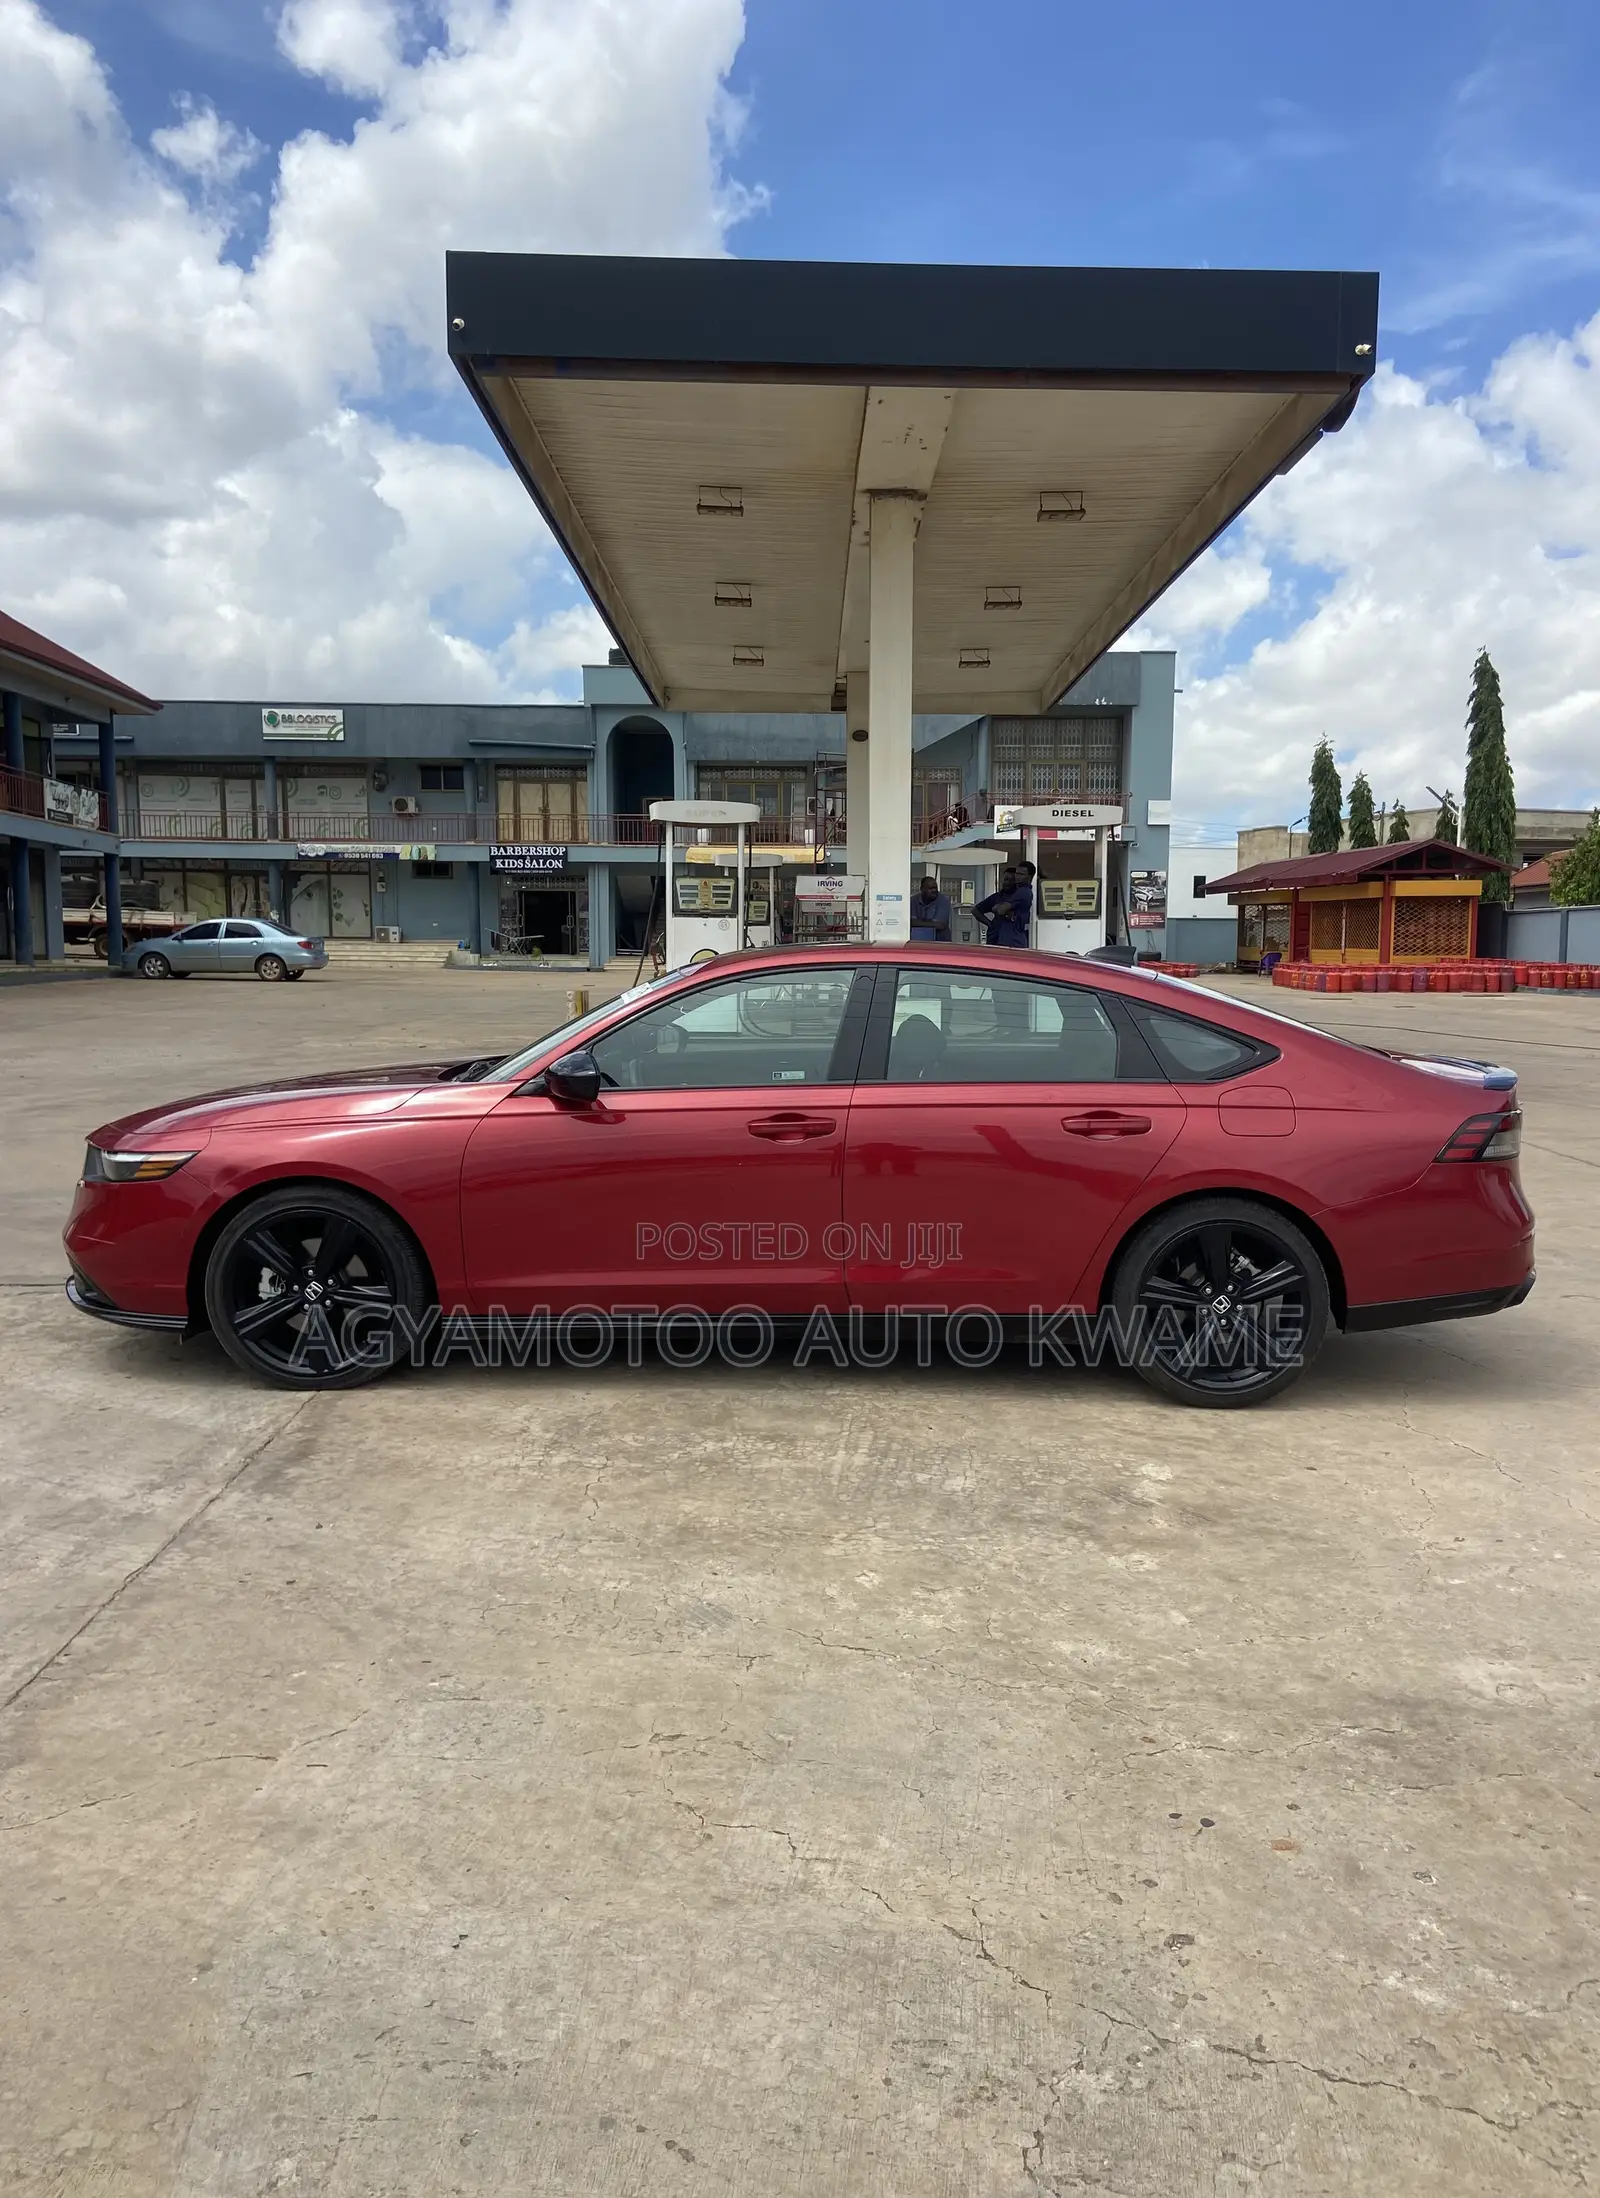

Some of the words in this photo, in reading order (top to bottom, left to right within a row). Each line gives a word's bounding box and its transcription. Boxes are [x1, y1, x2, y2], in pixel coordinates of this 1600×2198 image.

[490, 846, 566, 856] BARBERSHOP
[495, 859, 523, 868] KIDS
[524, 859, 563, 868] SALON
